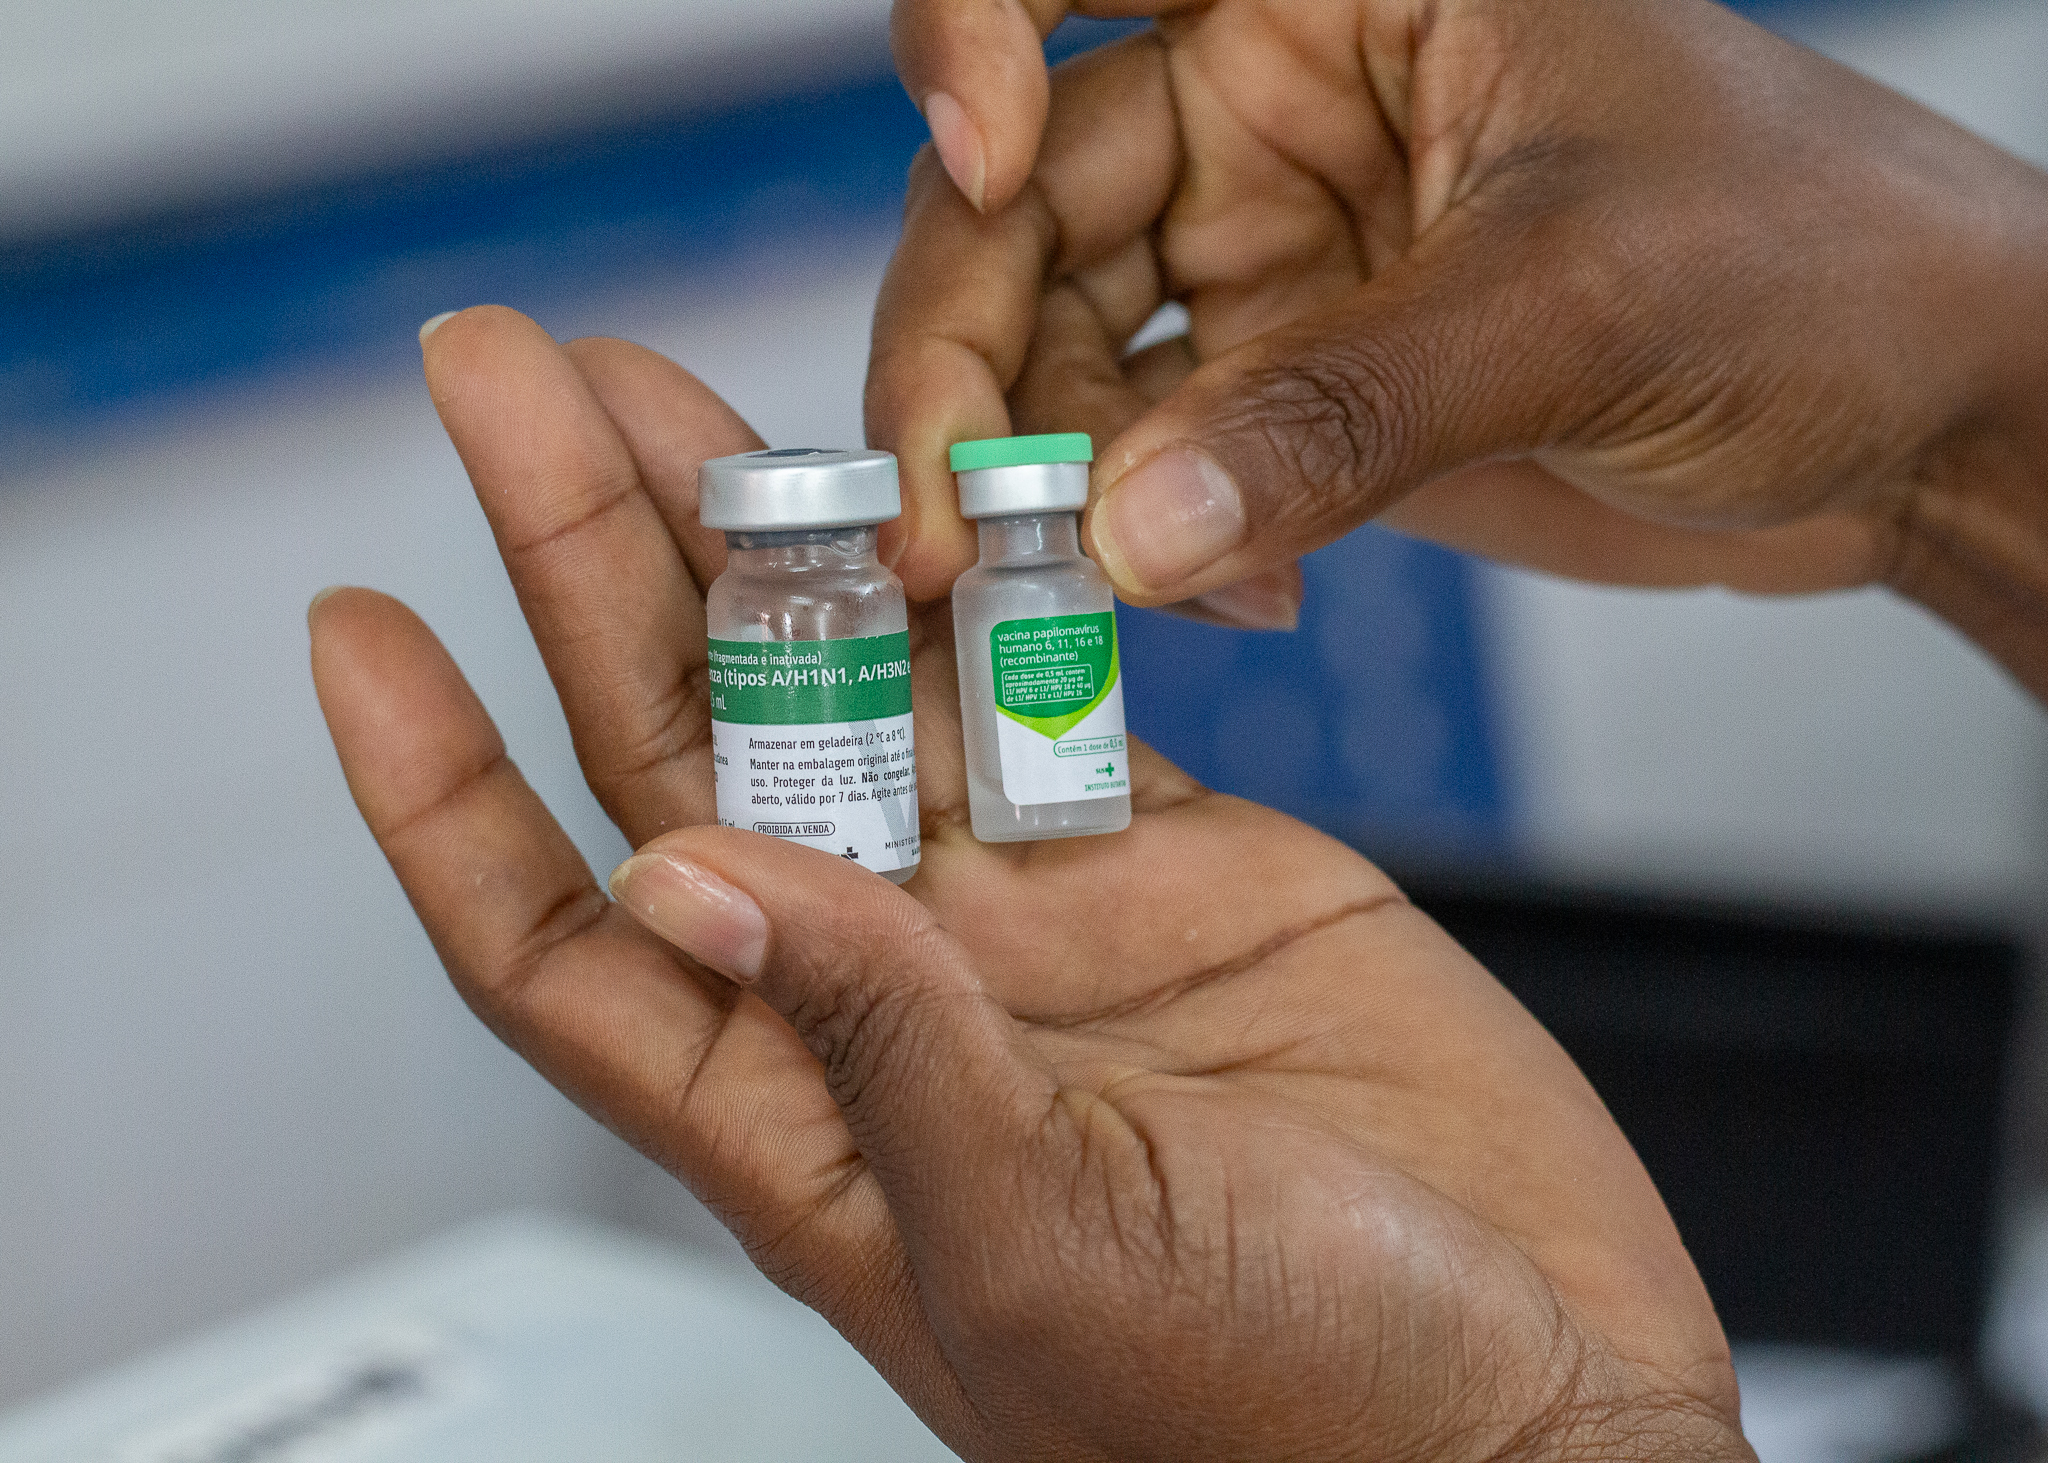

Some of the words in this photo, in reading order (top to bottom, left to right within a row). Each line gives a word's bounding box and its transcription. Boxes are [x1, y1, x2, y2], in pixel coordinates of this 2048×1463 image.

[997, 630, 1030, 642] vacina
[1033, 624, 1100, 640] papilomavírus
[999, 643, 1042, 654] humano
[1045, 640, 1054, 650] 6,
[1058, 639, 1072, 649] 11,
[1075, 638, 1086, 647] 16
[1095, 636, 1104, 645] 18
[770, 651, 822, 665] inativada)
[1000, 651, 1078, 668] (recombinante)
[724, 668, 766, 690] (tipos
[772, 668, 852, 686] A/H1N1,
[858, 660, 906, 682] A/H3N2
[1006, 678, 1058, 688] aproximadamente
[748, 738, 797, 750] Armazenar
[800, 740, 815, 749] em
[818, 736, 863, 751] geladeira
[866, 732, 874, 746] (2
[886, 734, 890, 742] a
[892, 730, 896, 741] 8
[1058, 744, 1082, 754] Contém
[1089, 742, 1102, 750] dose
[1110, 738, 1118, 750] 0,5
[750, 758, 780, 770] Manter
[783, 762, 794, 770] na
[798, 758, 854, 771] embalagem
[858, 752, 888, 768] original
[890, 750, 900, 762] até
[750, 778, 768, 788] uso.
[774, 776, 816, 790] Proteger
[822, 776, 834, 786] da
[840, 774, 856, 786] luz.
[862, 771, 878, 784] Não
[884, 766, 910, 781] congelar.
[1084, 782, 1110, 792] INSTITUTO
[752, 793, 782, 806] aberto,
[786, 793, 816, 805] válido
[820, 794, 836, 806] por
[839, 792, 844, 803] 7
[848, 791, 868, 802] dias.
[872, 788, 890, 802] Agite
[893, 784, 908, 797] antes
[758, 824, 794, 834] PROIBIDA
[795, 825, 801, 834] A
[803, 824, 830, 834] VENDA
